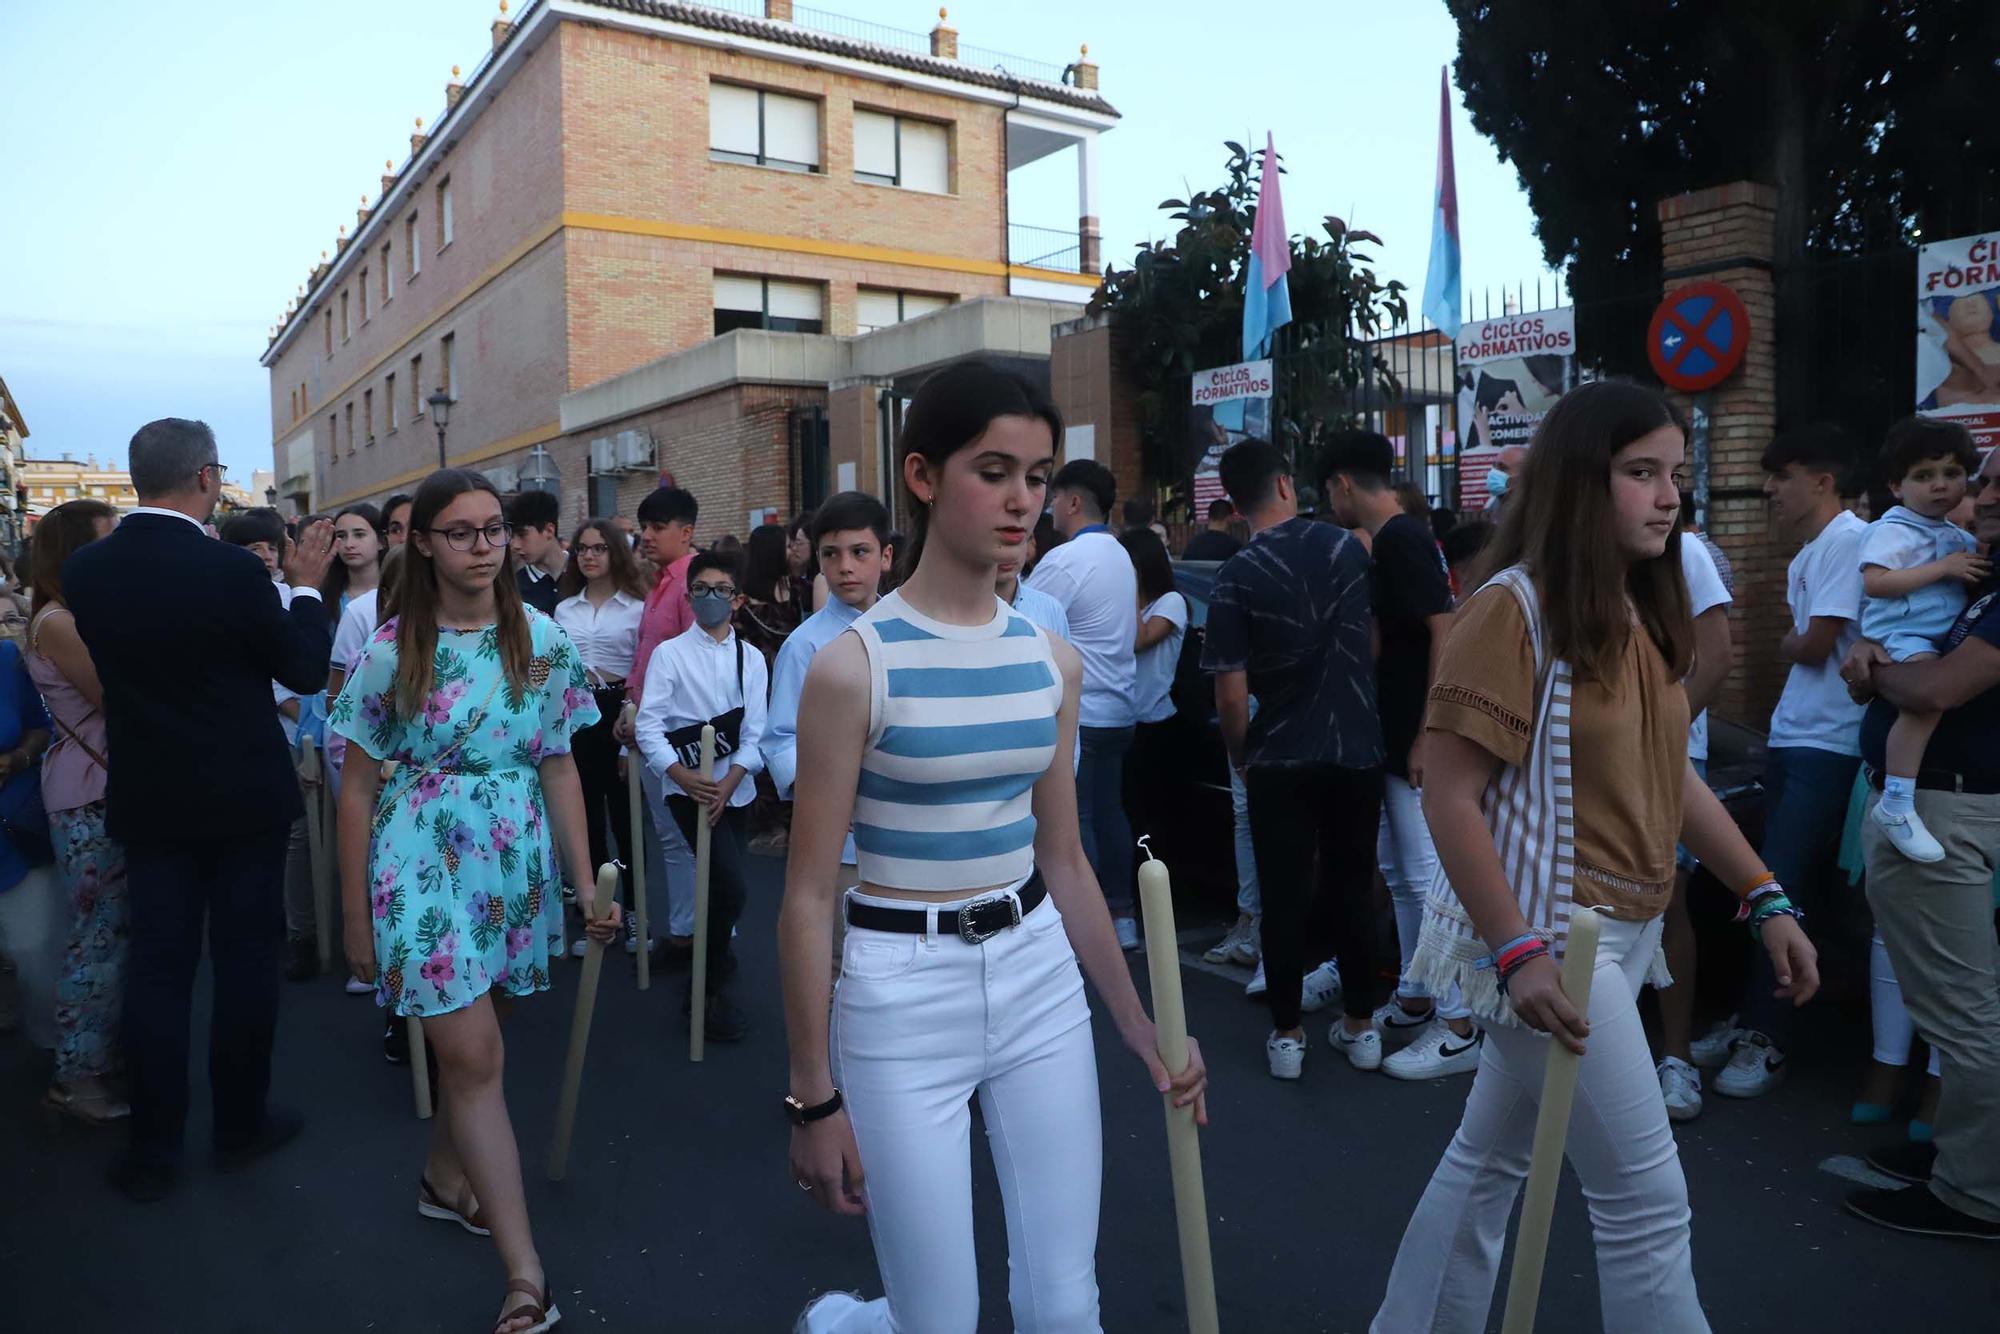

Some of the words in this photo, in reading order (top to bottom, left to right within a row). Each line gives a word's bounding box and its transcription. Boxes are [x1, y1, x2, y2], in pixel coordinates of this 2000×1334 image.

[1969, 239, 2000, 264] CI
[1926, 264, 2000, 291] FORM
[1482, 318, 1544, 341] CICLOS
[1460, 331, 1571, 360] FORMATIVOS
[1211, 367, 1250, 386] CICLOS
[1195, 378, 1270, 401] FORMATIVOS
[1488, 411, 1544, 426] ACTIVIDA
